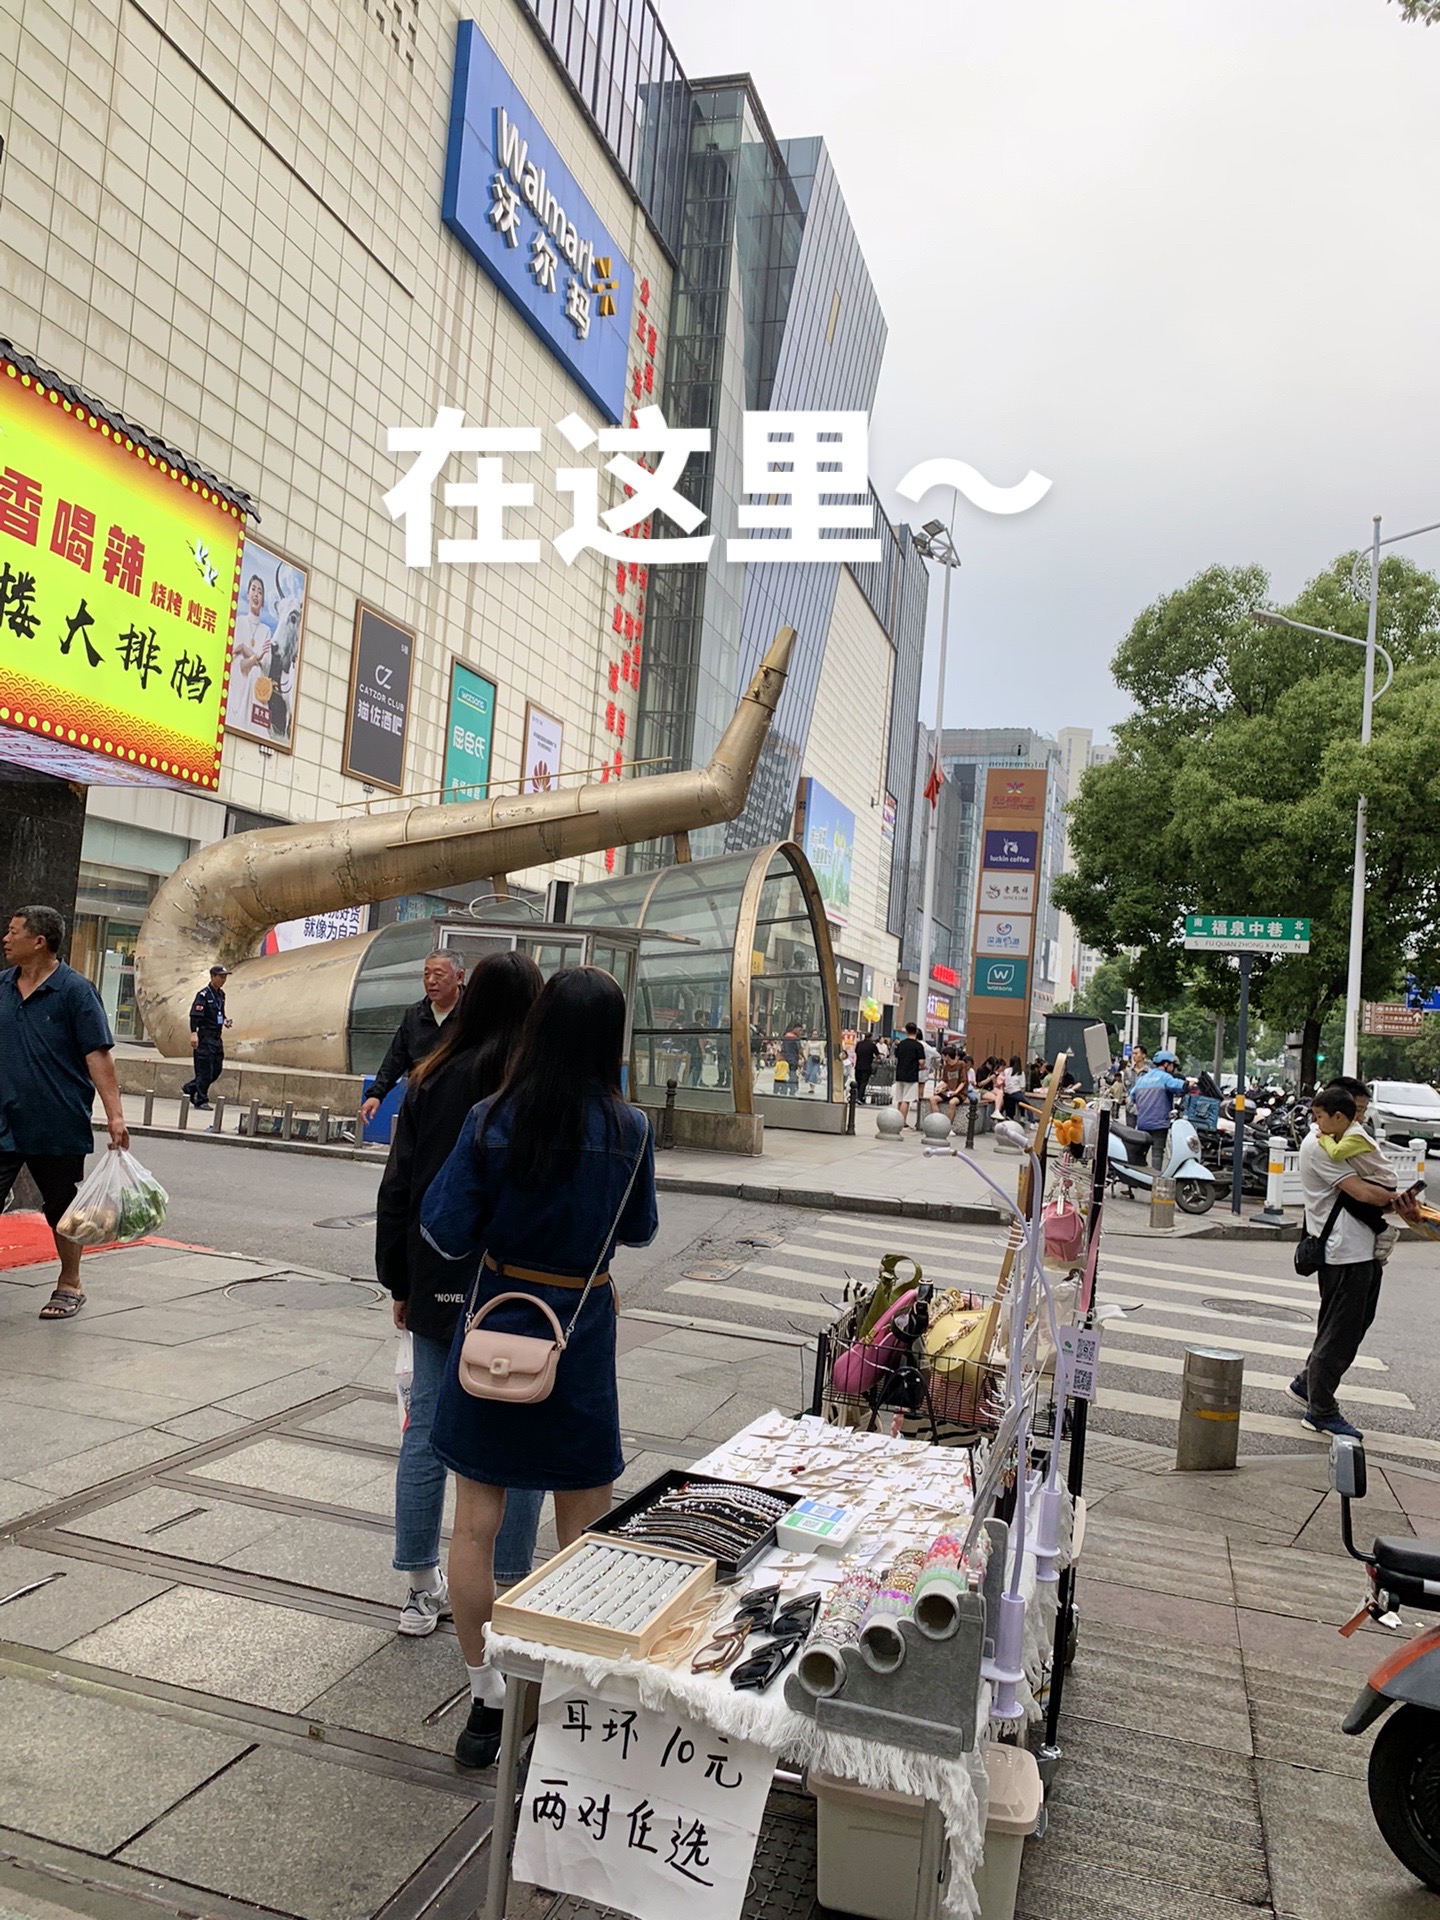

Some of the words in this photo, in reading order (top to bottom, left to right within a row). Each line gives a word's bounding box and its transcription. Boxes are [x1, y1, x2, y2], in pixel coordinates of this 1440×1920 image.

[493, 106, 596, 289] Walmart
[488, 172, 591, 340] 沃尔玛
[150, 580, 182, 618] 烧烤
[186, 599, 218, 634] 炒菜
[359, 683, 387, 704] CATZOR
[387, 697, 405, 712] CLUB
[357, 698, 403, 736] 猫佐酒吧
[453, 724, 486, 760] 屈臣氏
[989, 854, 1009, 863] luckin
[1009, 855, 1030, 864] coffee
[1193, 918, 1203, 927] 南
[1211, 920, 1284, 938] 福泉中巷
[1294, 920, 1304, 930] 北
[1237, 941, 1264, 949] ZHONG
[562, 1699, 639, 1760] 耳环
[532, 1779, 714, 1888] 两对任选
